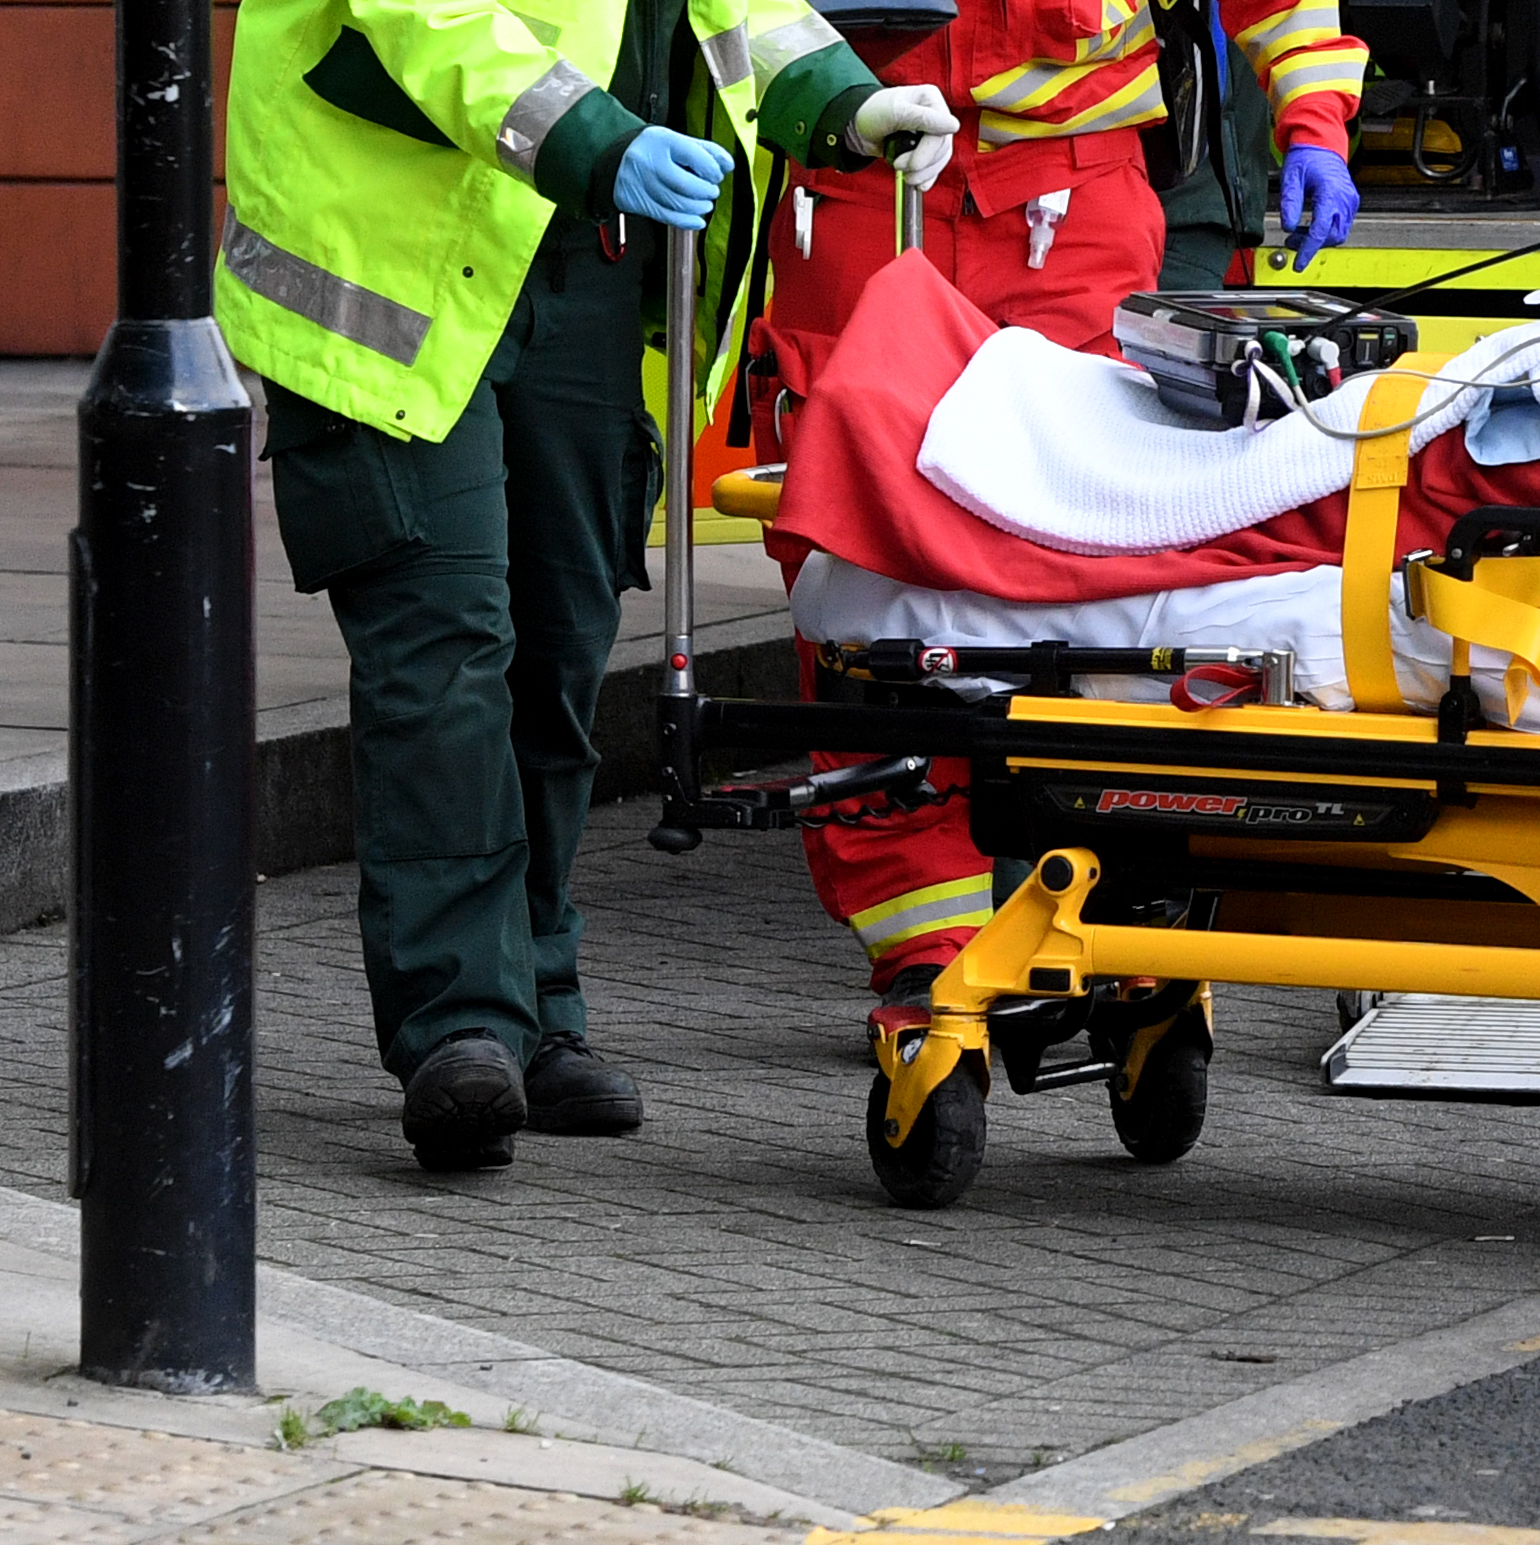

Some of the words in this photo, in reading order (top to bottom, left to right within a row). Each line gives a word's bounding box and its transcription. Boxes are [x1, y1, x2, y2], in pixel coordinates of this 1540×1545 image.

[1097, 789, 1247, 814] power
[1246, 804, 1312, 824] pro
[1316, 802, 1345, 816] TL
